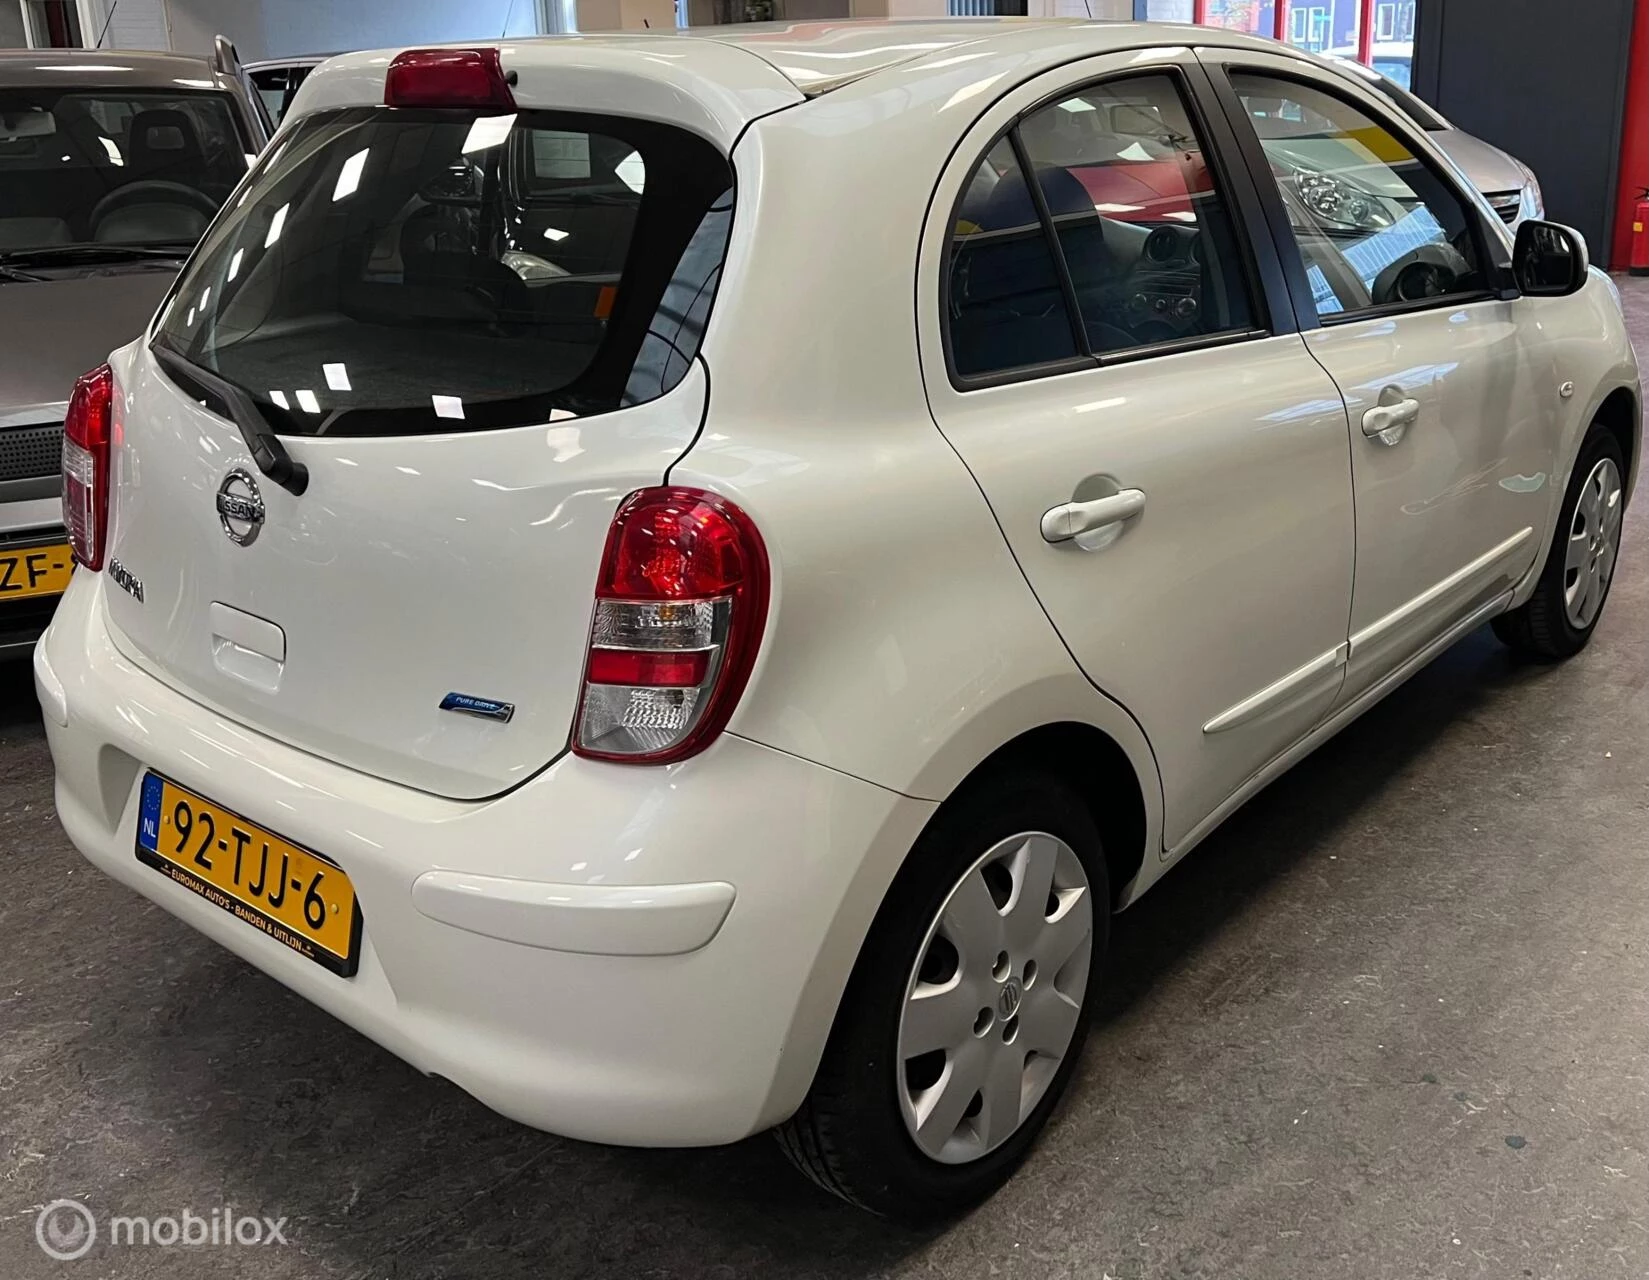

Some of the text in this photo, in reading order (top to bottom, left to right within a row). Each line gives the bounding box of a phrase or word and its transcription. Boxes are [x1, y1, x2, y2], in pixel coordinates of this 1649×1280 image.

[455, 696, 474, 705] PURE
[143, 817, 157, 838] NL
[173, 800, 326, 930] 92-TJJ-6
[171, 868, 205, 896] EUROMAX
[205, 888, 230, 909] AUTO'S
[235, 904, 266, 930] BANDEN
[266, 923, 273, 935] &
